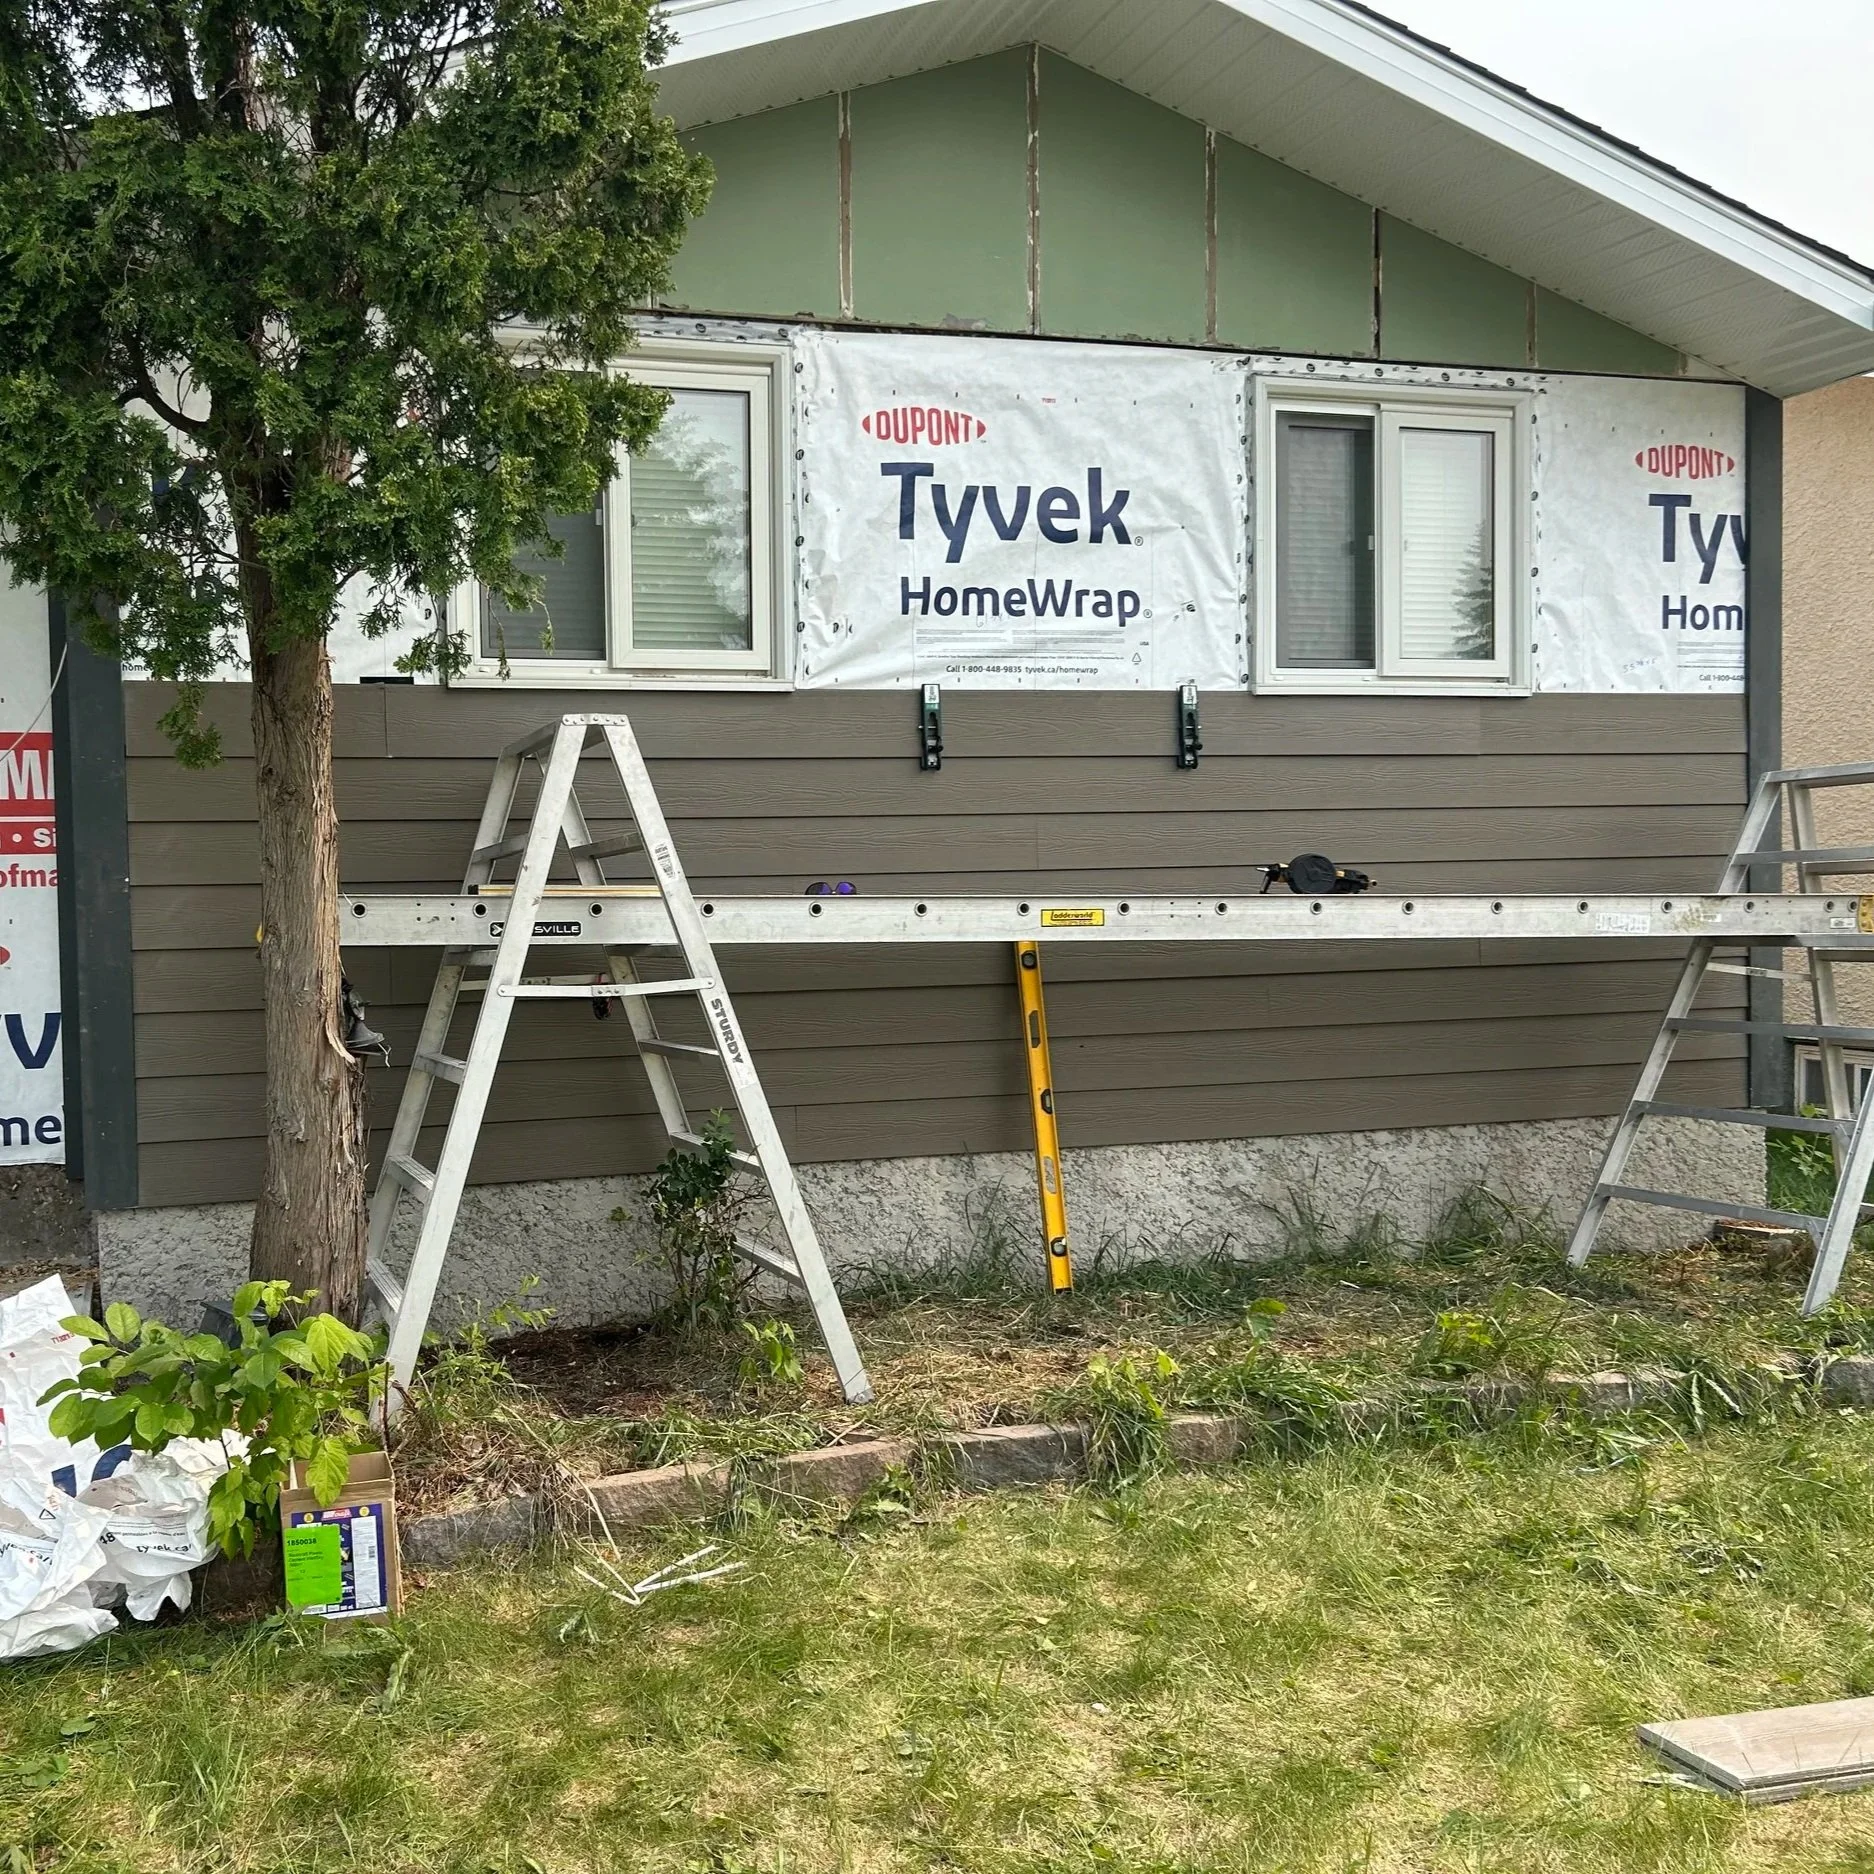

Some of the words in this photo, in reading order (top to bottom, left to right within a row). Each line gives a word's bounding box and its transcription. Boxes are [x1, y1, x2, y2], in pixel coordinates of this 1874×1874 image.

[876, 407, 972, 446] DUPONT
[1647, 445, 1724, 480] DUPONT
[880, 462, 1132, 563] Tyvek
[900, 576, 1141, 627] HomeWrap
[1662, 595, 1744, 631] Hom
[946, 665, 960, 673] Call
[962, 665, 1022, 673] 1-800-448-9835
[1025, 665, 1099, 675] tyvek.ca/homewrap
[711, 998, 744, 1064] STURDY
